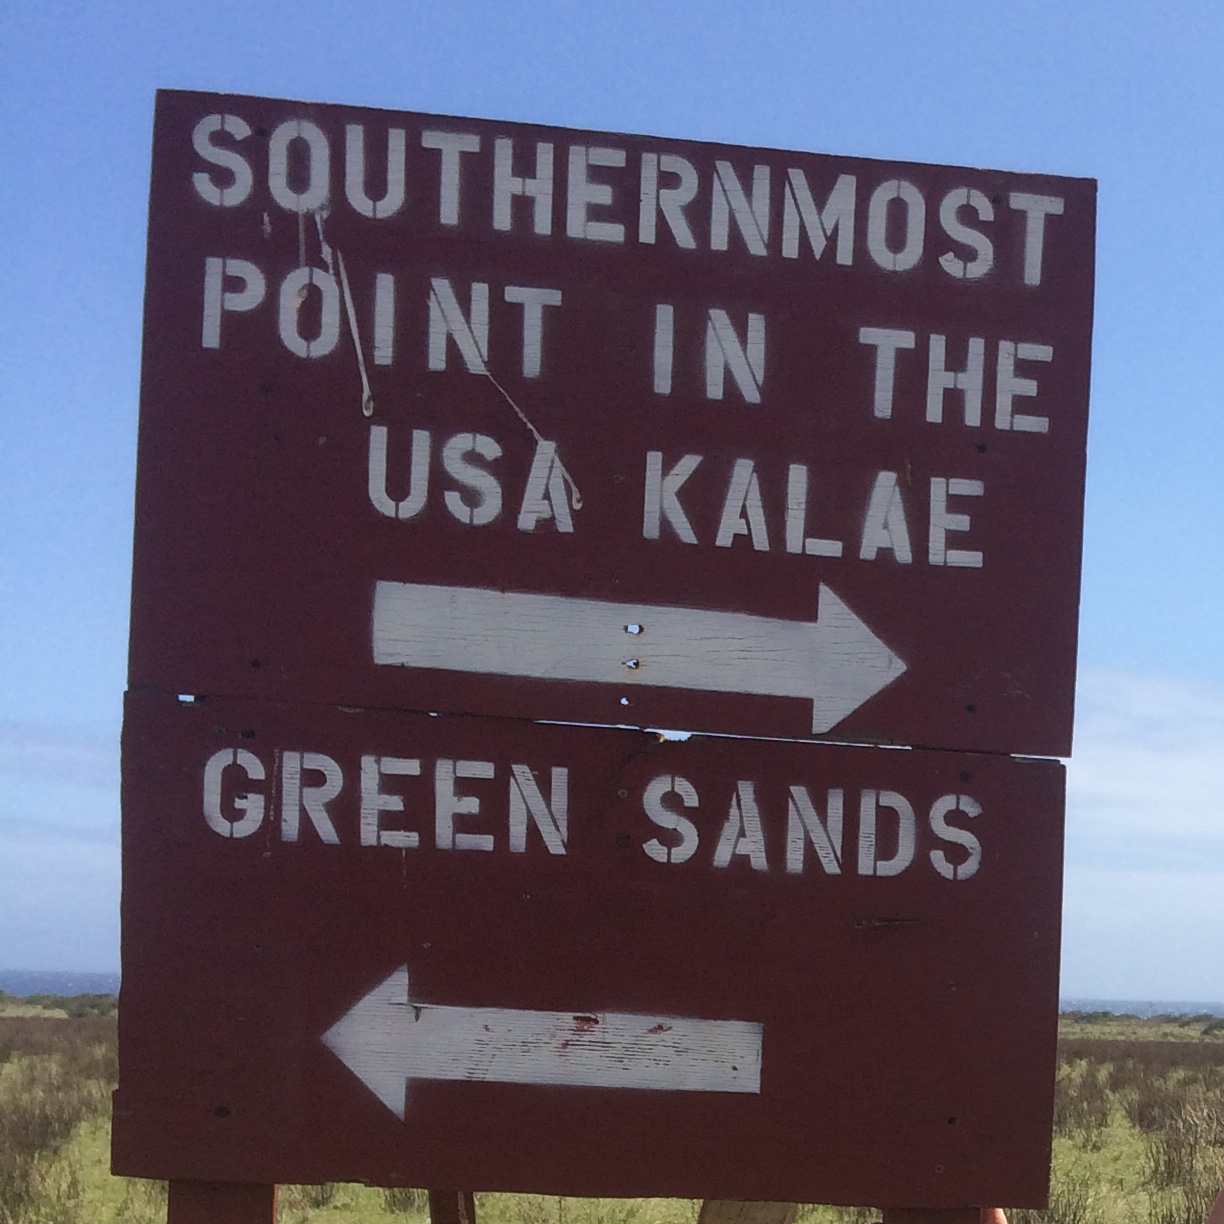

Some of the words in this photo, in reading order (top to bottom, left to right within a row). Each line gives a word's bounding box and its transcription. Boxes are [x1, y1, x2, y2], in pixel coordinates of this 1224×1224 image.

[191, 114, 1065, 286] SOUTHERNMOST
[202, 258, 562, 376] POINT
[653, 304, 766, 404] IN
[858, 327, 1054, 433] THE
[367, 426, 575, 533] USA
[643, 451, 984, 568] KALAE
[203, 748, 568, 856] GREEN
[642, 775, 984, 881] SANDS
